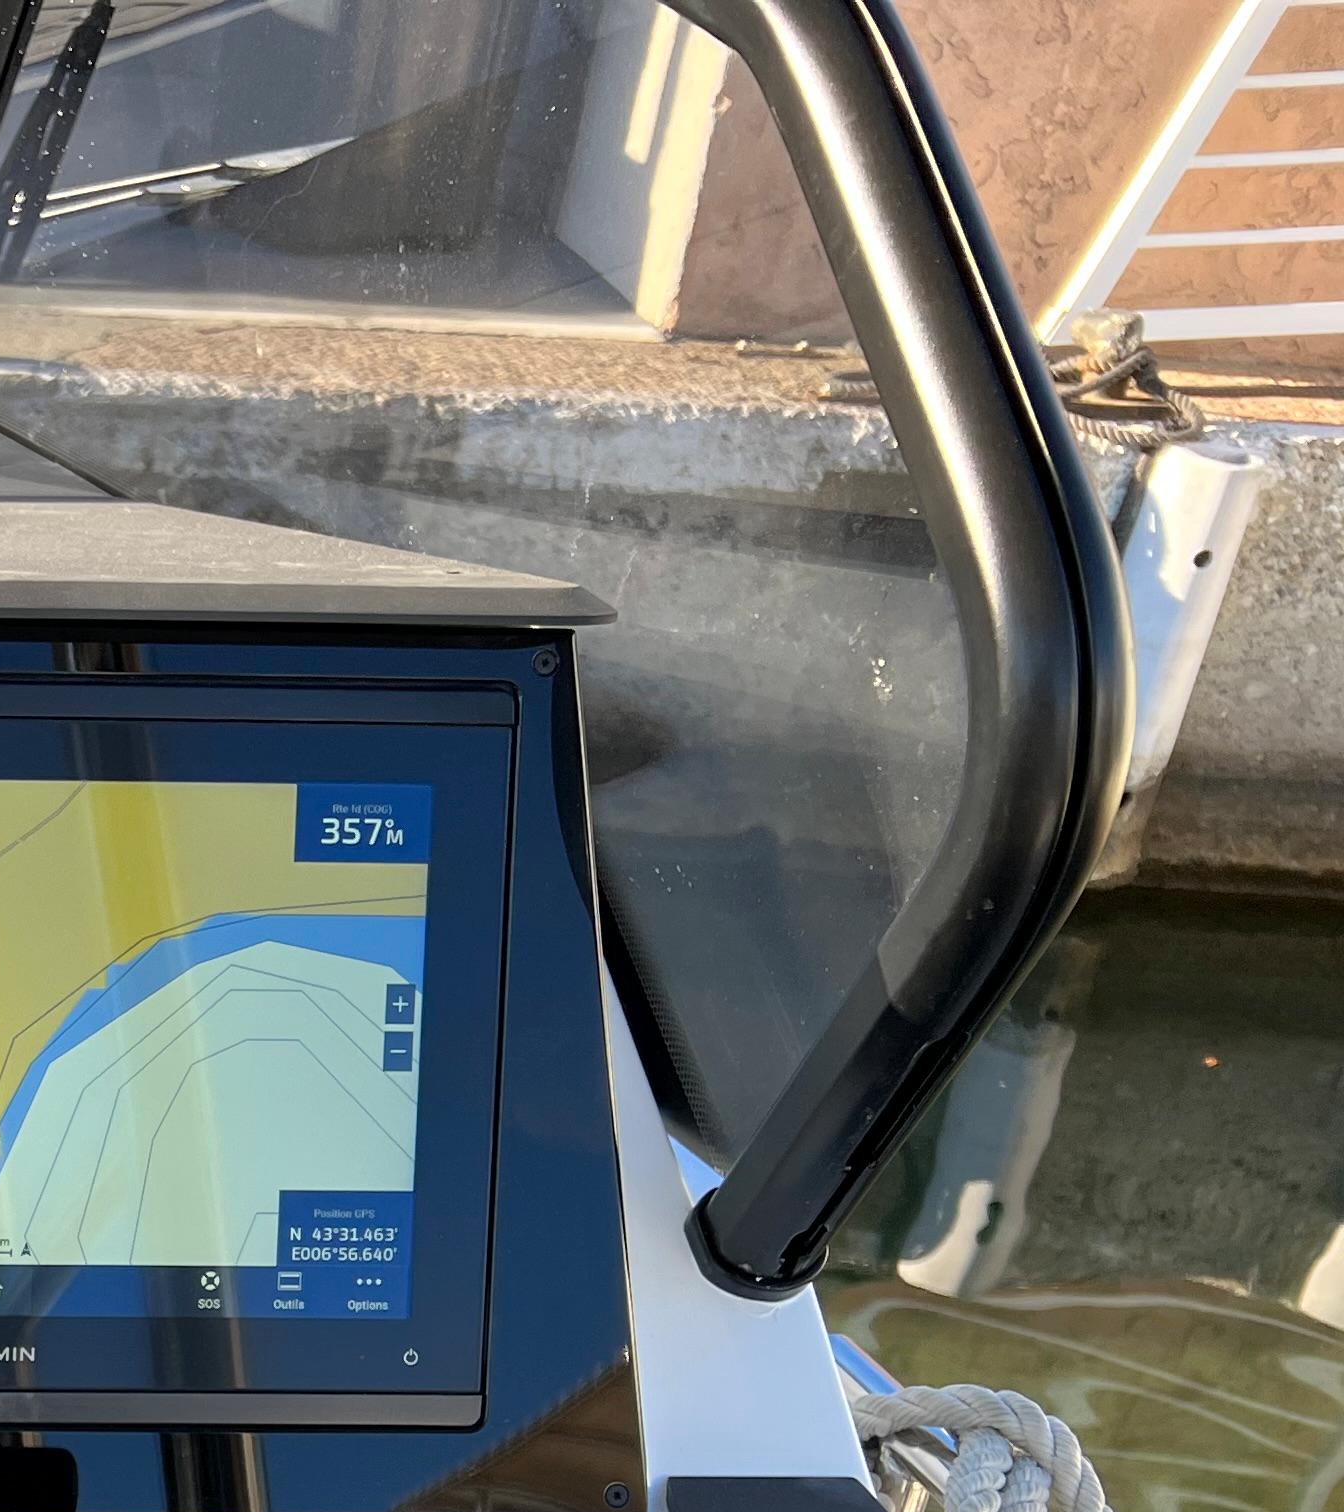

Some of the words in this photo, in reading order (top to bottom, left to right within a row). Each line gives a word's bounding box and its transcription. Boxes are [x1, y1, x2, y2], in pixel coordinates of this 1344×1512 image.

[313, 1208, 352, 1219] Position
[354, 1208, 376, 1219] GPS
[289, 1227, 302, 1242] N
[197, 1299, 221, 1311] SOS
[273, 1299, 305, 1311] Outils
[347, 1299, 389, 1313] Options
